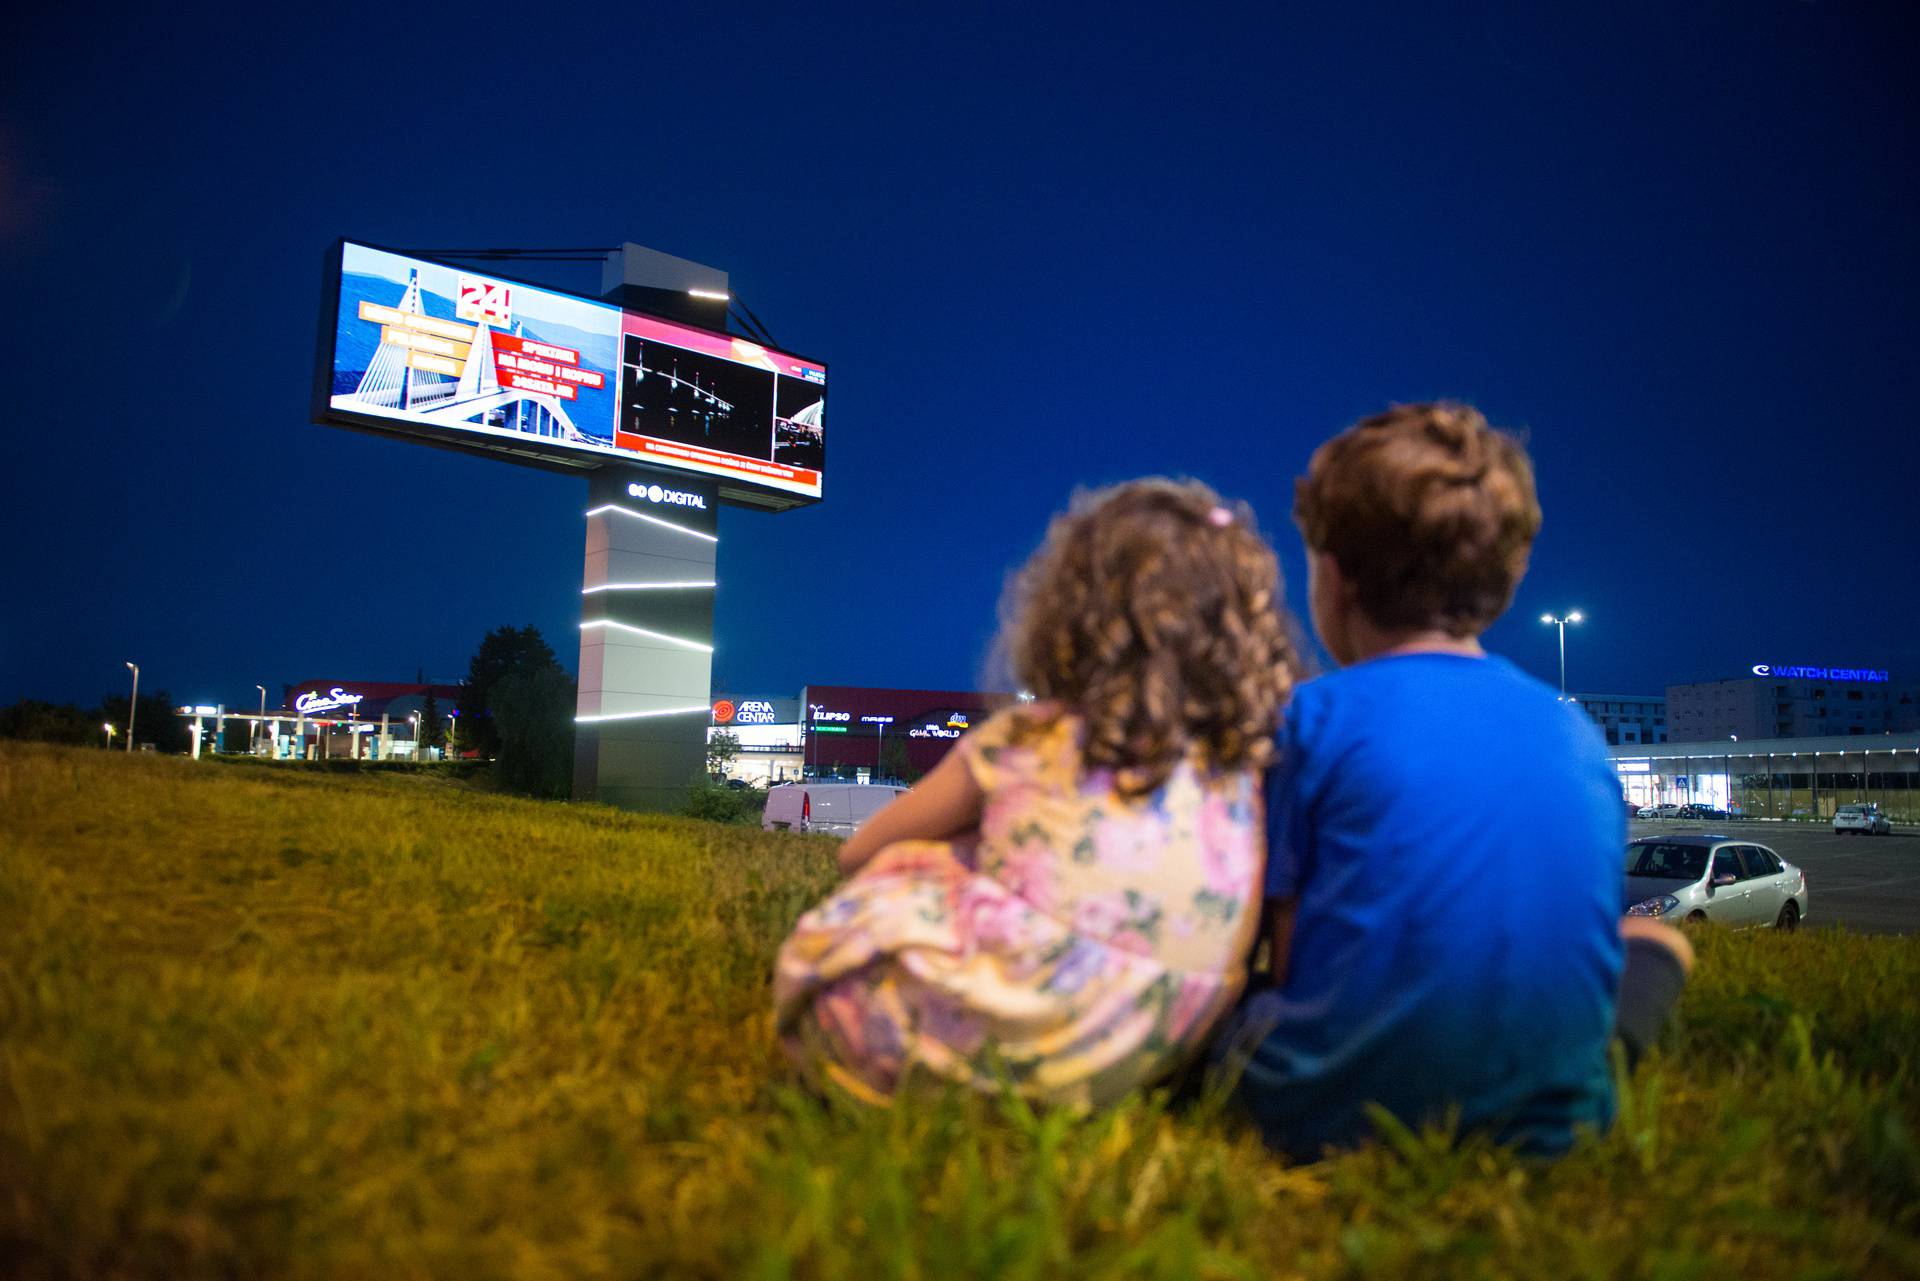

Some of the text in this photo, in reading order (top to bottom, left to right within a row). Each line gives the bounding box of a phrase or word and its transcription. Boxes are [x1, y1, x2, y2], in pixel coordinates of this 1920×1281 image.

[1773, 665, 1889, 682] WATCH CENTAR
[738, 701, 774, 712] ARENA
[737, 711, 775, 723] CENTAR
[813, 711, 850, 721] ELIPSO
